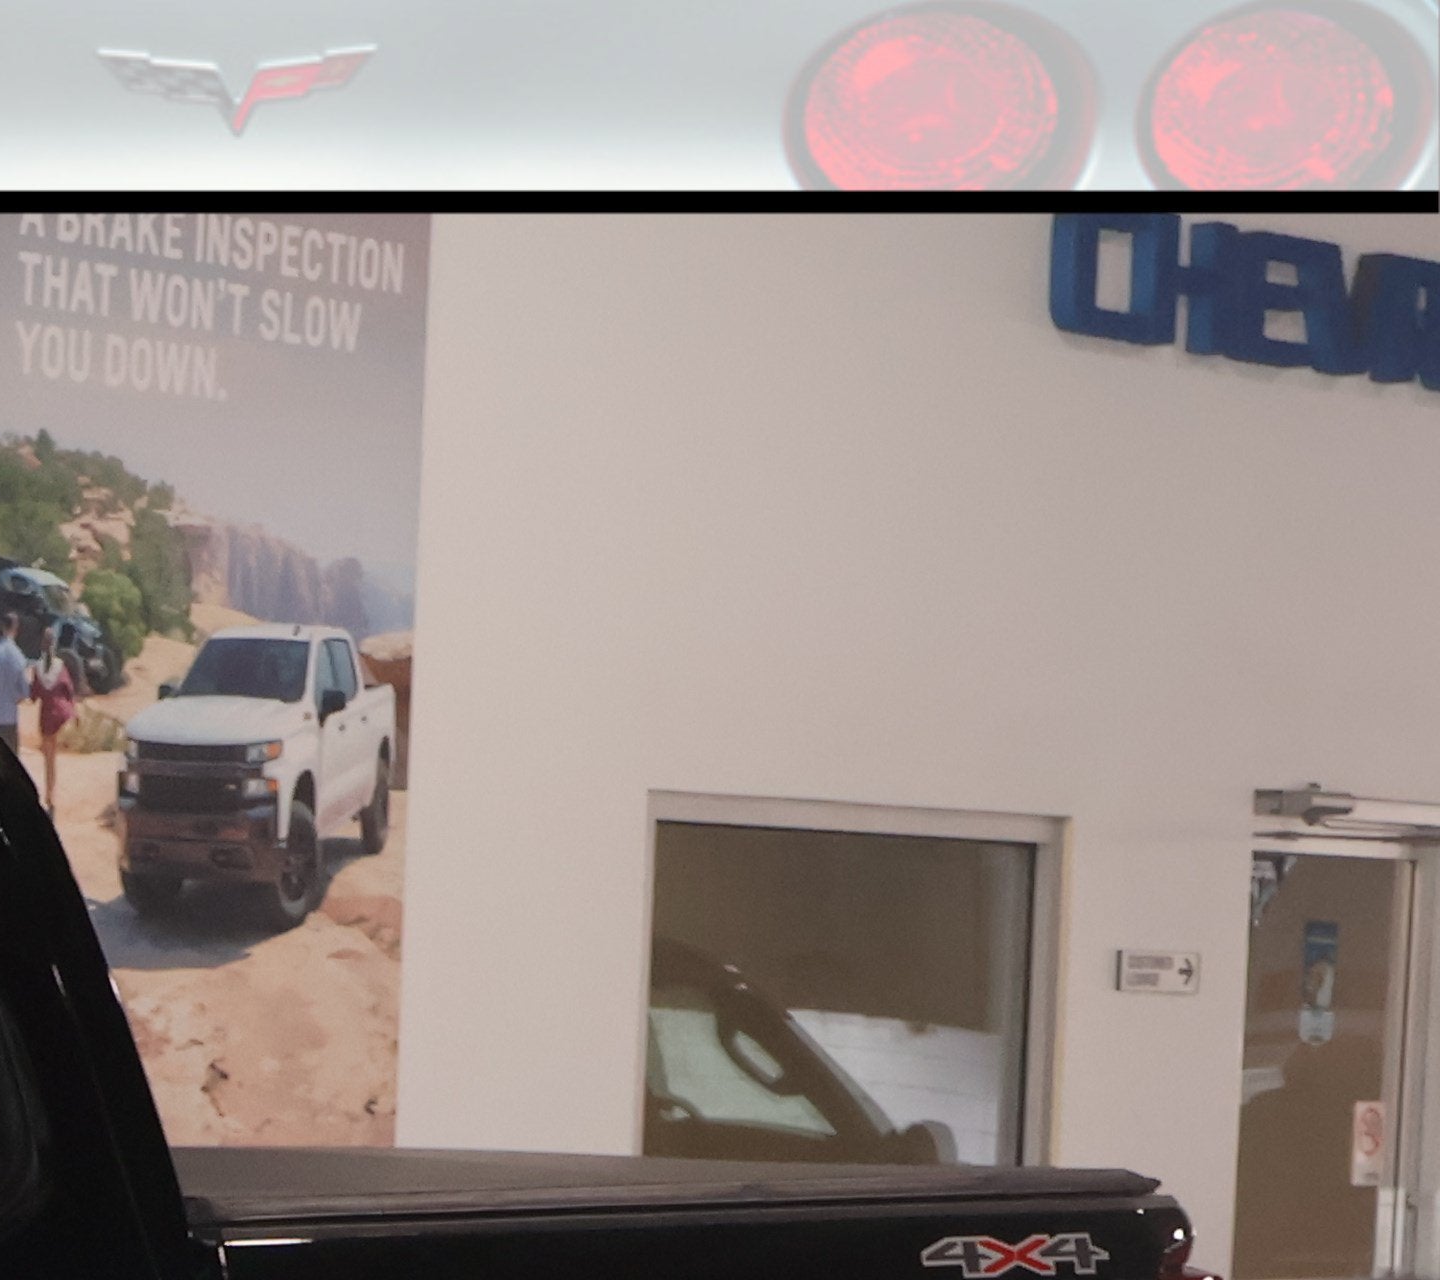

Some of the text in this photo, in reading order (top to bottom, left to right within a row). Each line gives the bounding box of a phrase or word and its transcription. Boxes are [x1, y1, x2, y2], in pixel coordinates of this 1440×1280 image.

[56, 213, 183, 260] BRAKE
[194, 213, 405, 295] INSPECTION
[18, 251, 362, 352] THAT WON'T SLOW
[14, 319, 227, 400] YOU DOWN.
